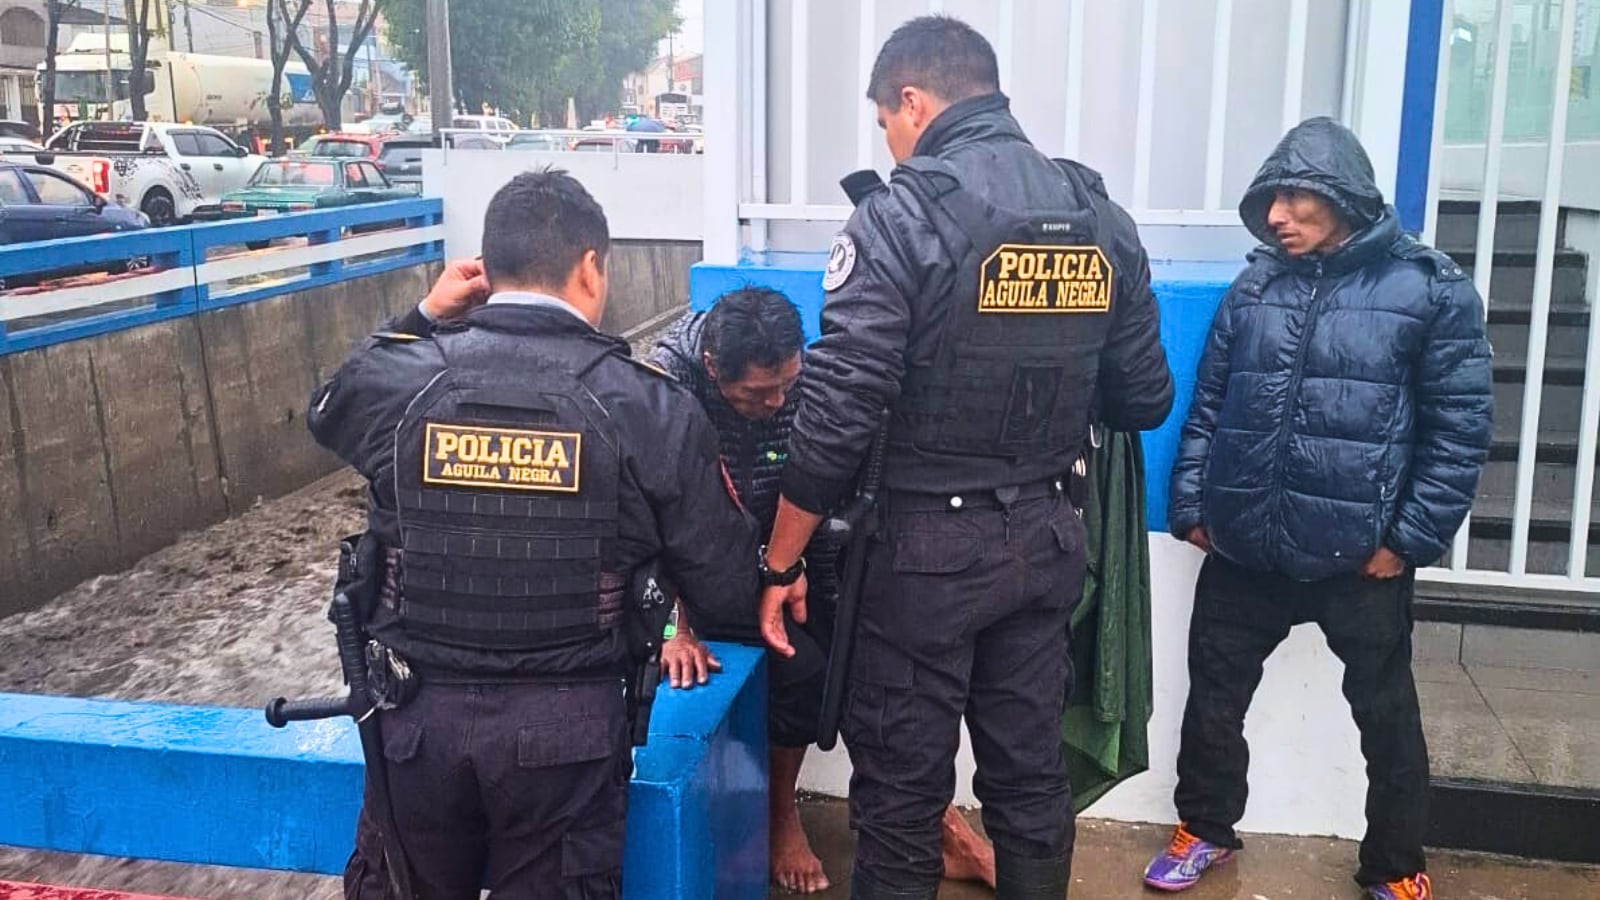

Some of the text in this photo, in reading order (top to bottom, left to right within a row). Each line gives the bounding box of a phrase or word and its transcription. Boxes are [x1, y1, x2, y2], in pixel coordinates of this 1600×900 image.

[999, 252, 1103, 280] POLICIA
[983, 279, 1108, 307] AGUILA NEGRA
[435, 431, 569, 468] POLICIA
[441, 462, 562, 484] AGUILA NEGRA
